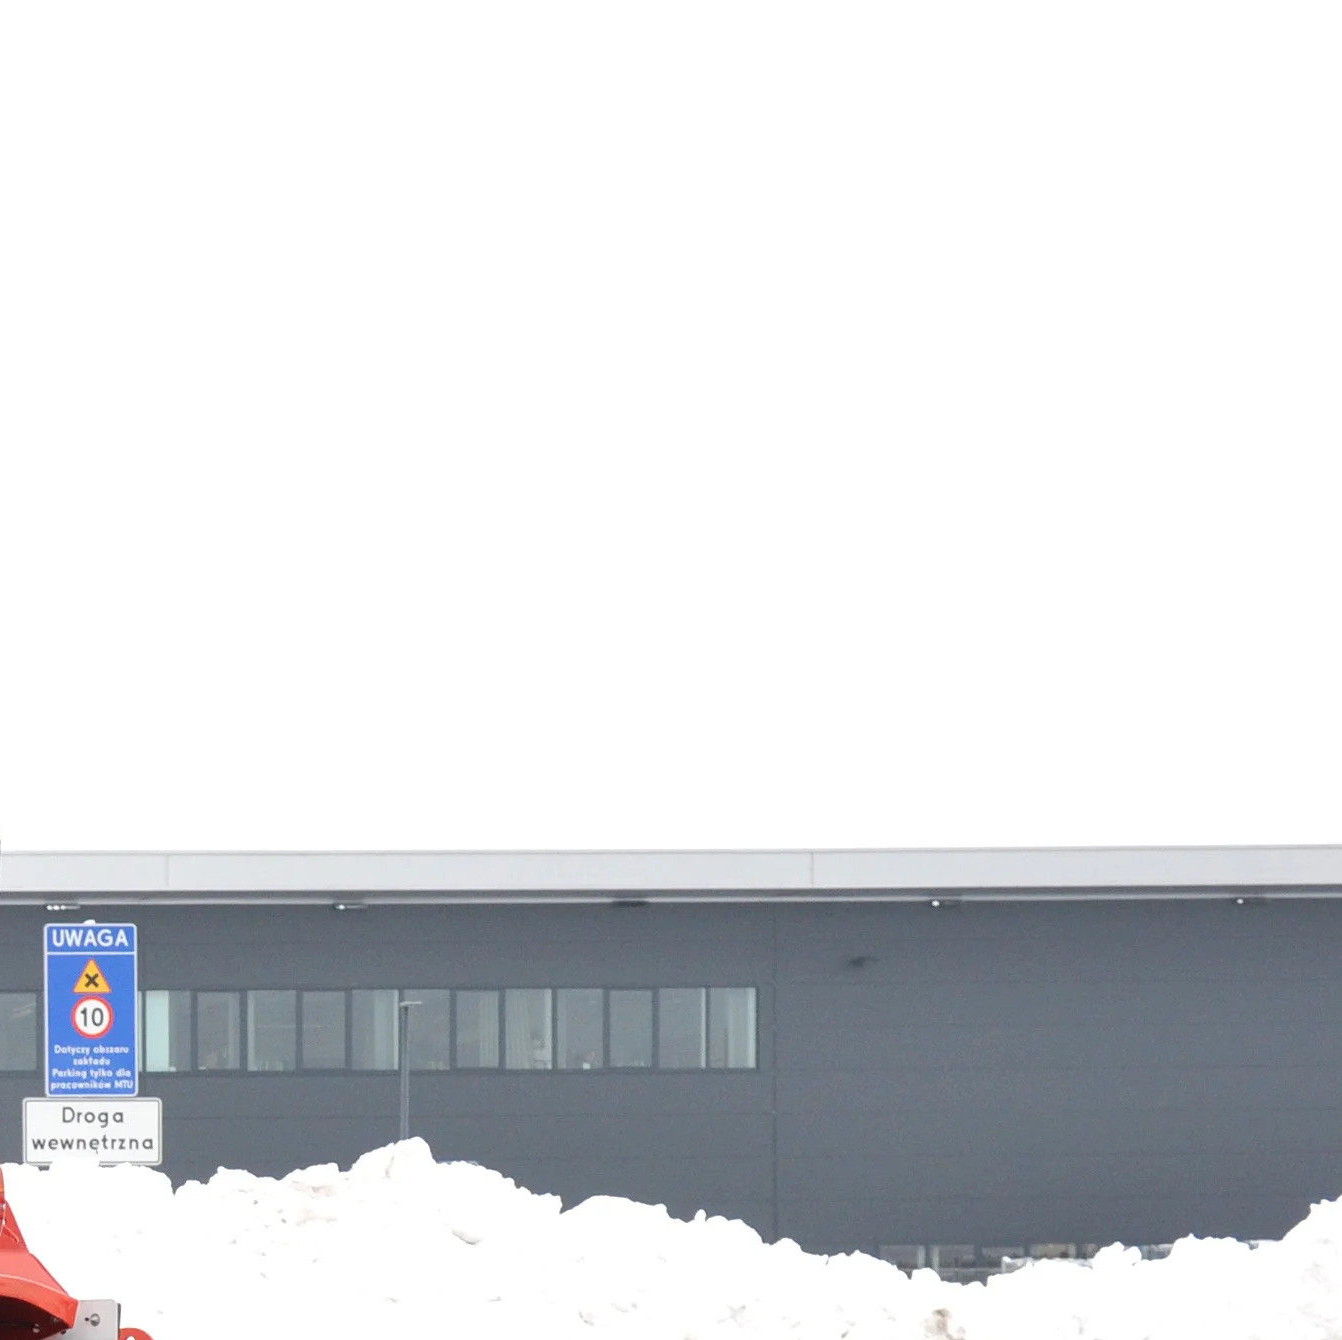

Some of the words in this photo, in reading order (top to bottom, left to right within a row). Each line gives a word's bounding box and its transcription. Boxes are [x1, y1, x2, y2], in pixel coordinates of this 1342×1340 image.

[52, 928, 129, 947] UWAGA
[80, 1007, 104, 1027] 10
[54, 1044, 90, 1055] Dotyczy
[93, 1044, 129, 1053] obszaru
[52, 1068, 87, 1079] Parking
[90, 1068, 113, 1079] tylko
[115, 1068, 131, 1077] dla
[51, 1080, 111, 1091] pracowników
[114, 1080, 133, 1089] MTU
[62, 1106, 124, 1128] Droga
[31, 1134, 154, 1155] wewnętrzna
